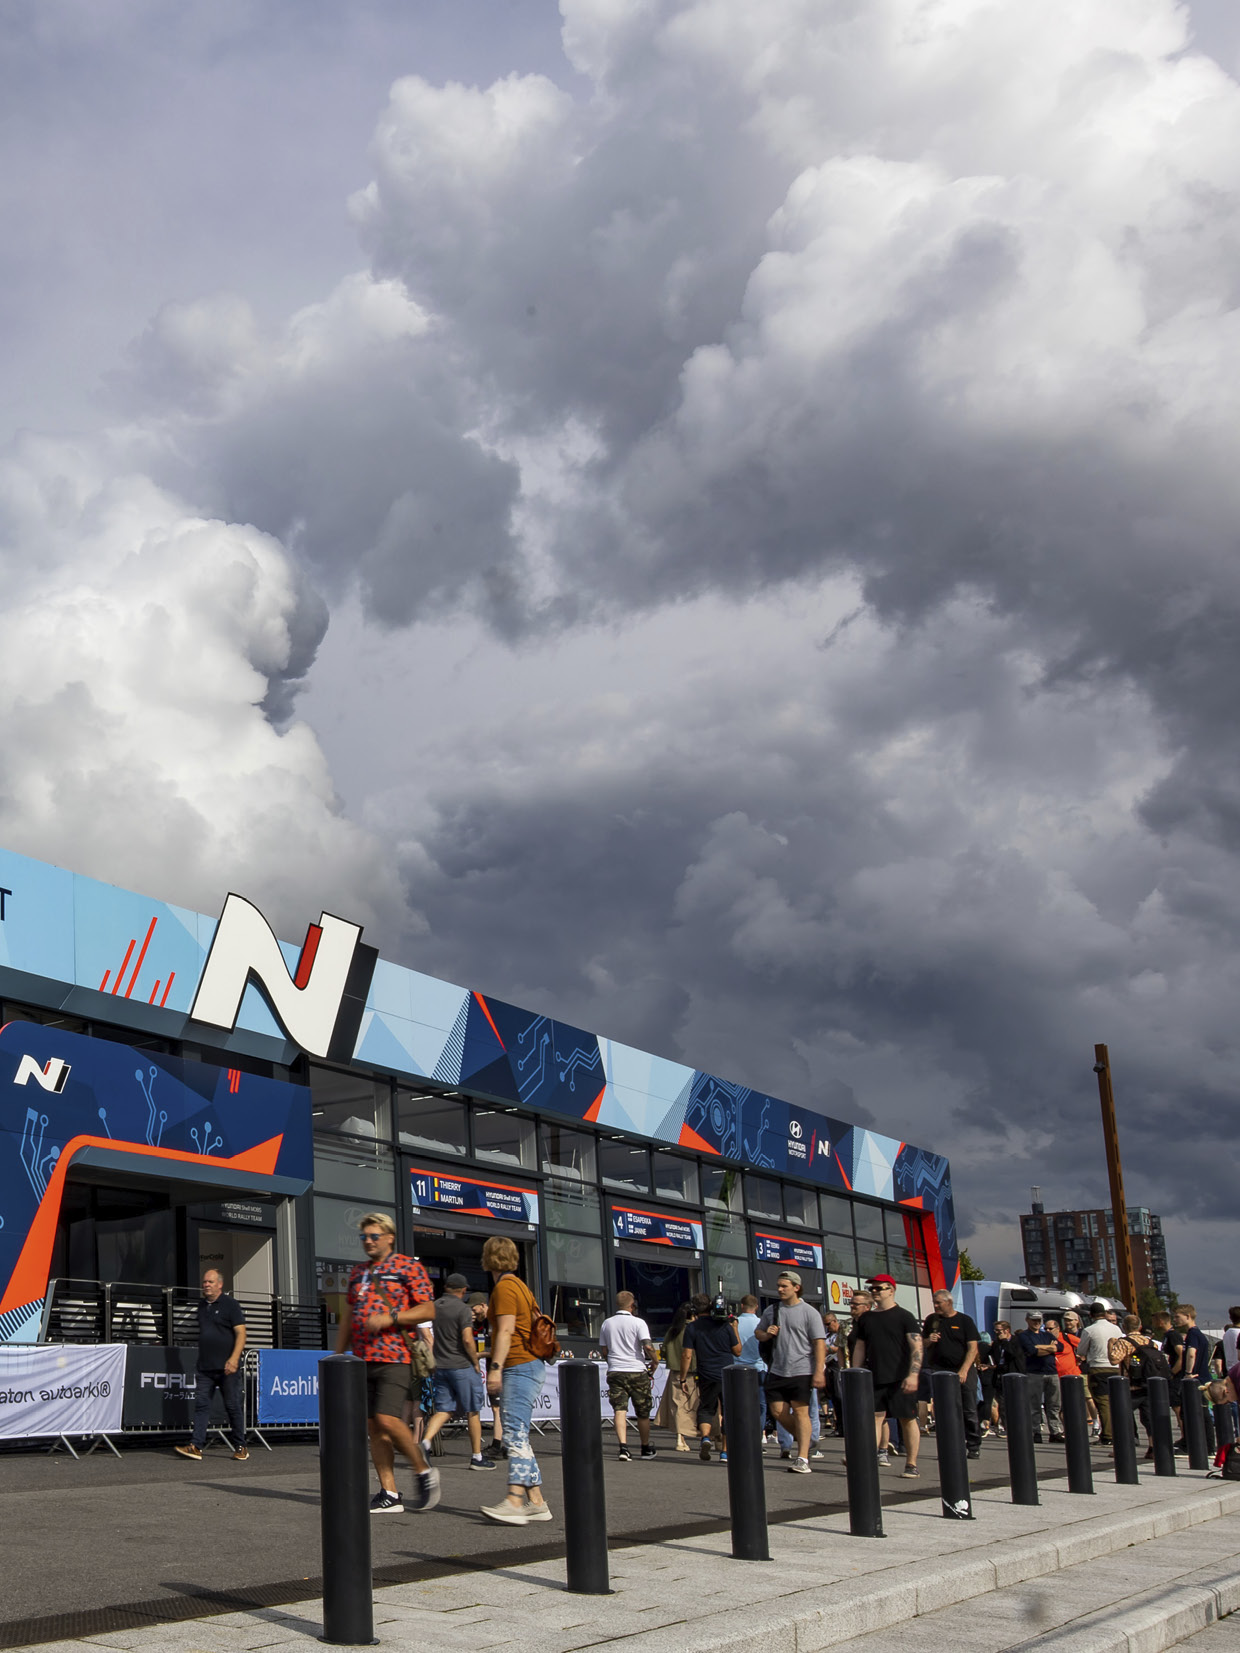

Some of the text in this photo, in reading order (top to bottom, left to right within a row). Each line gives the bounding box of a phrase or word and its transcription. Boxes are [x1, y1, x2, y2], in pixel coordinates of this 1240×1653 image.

[416, 1180, 426, 1196] 11
[439, 1180, 462, 1192] THIERRY
[486, 1201, 500, 1209] WORLD
[617, 1216, 624, 1230] 4
[633, 1228, 647, 1236] JANNE
[758, 1242, 764, 1254] 3
[140, 1372, 198, 1389] FORU
[163, 1391, 197, 1400] フォーラムエ
